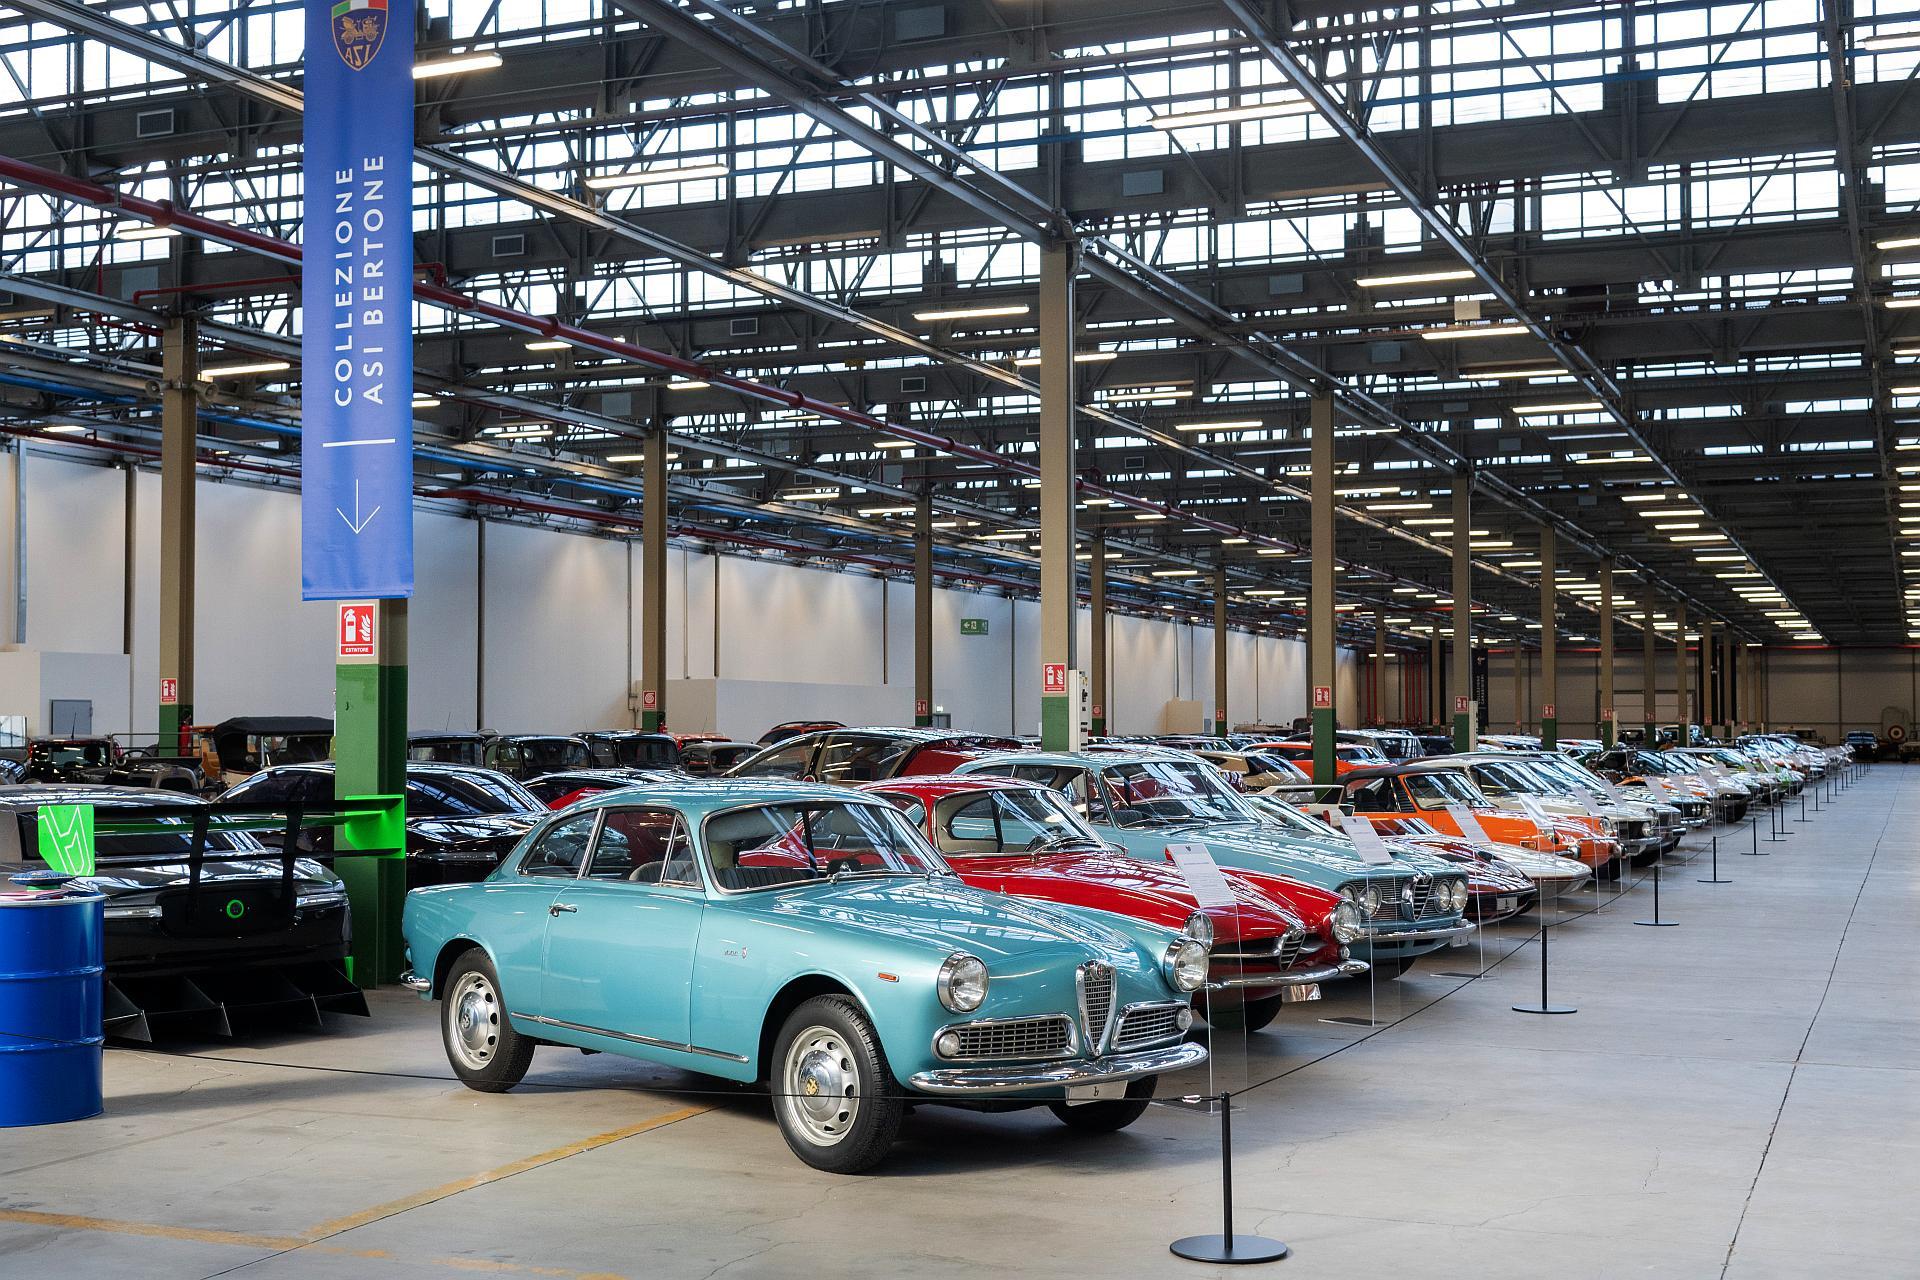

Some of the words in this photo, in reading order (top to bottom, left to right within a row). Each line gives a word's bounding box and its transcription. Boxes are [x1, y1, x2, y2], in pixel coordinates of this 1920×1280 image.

[334, 168, 353, 407] COLLEZIONE
[362, 155, 384, 325] BERTONE
[362, 347, 384, 405] ASI
